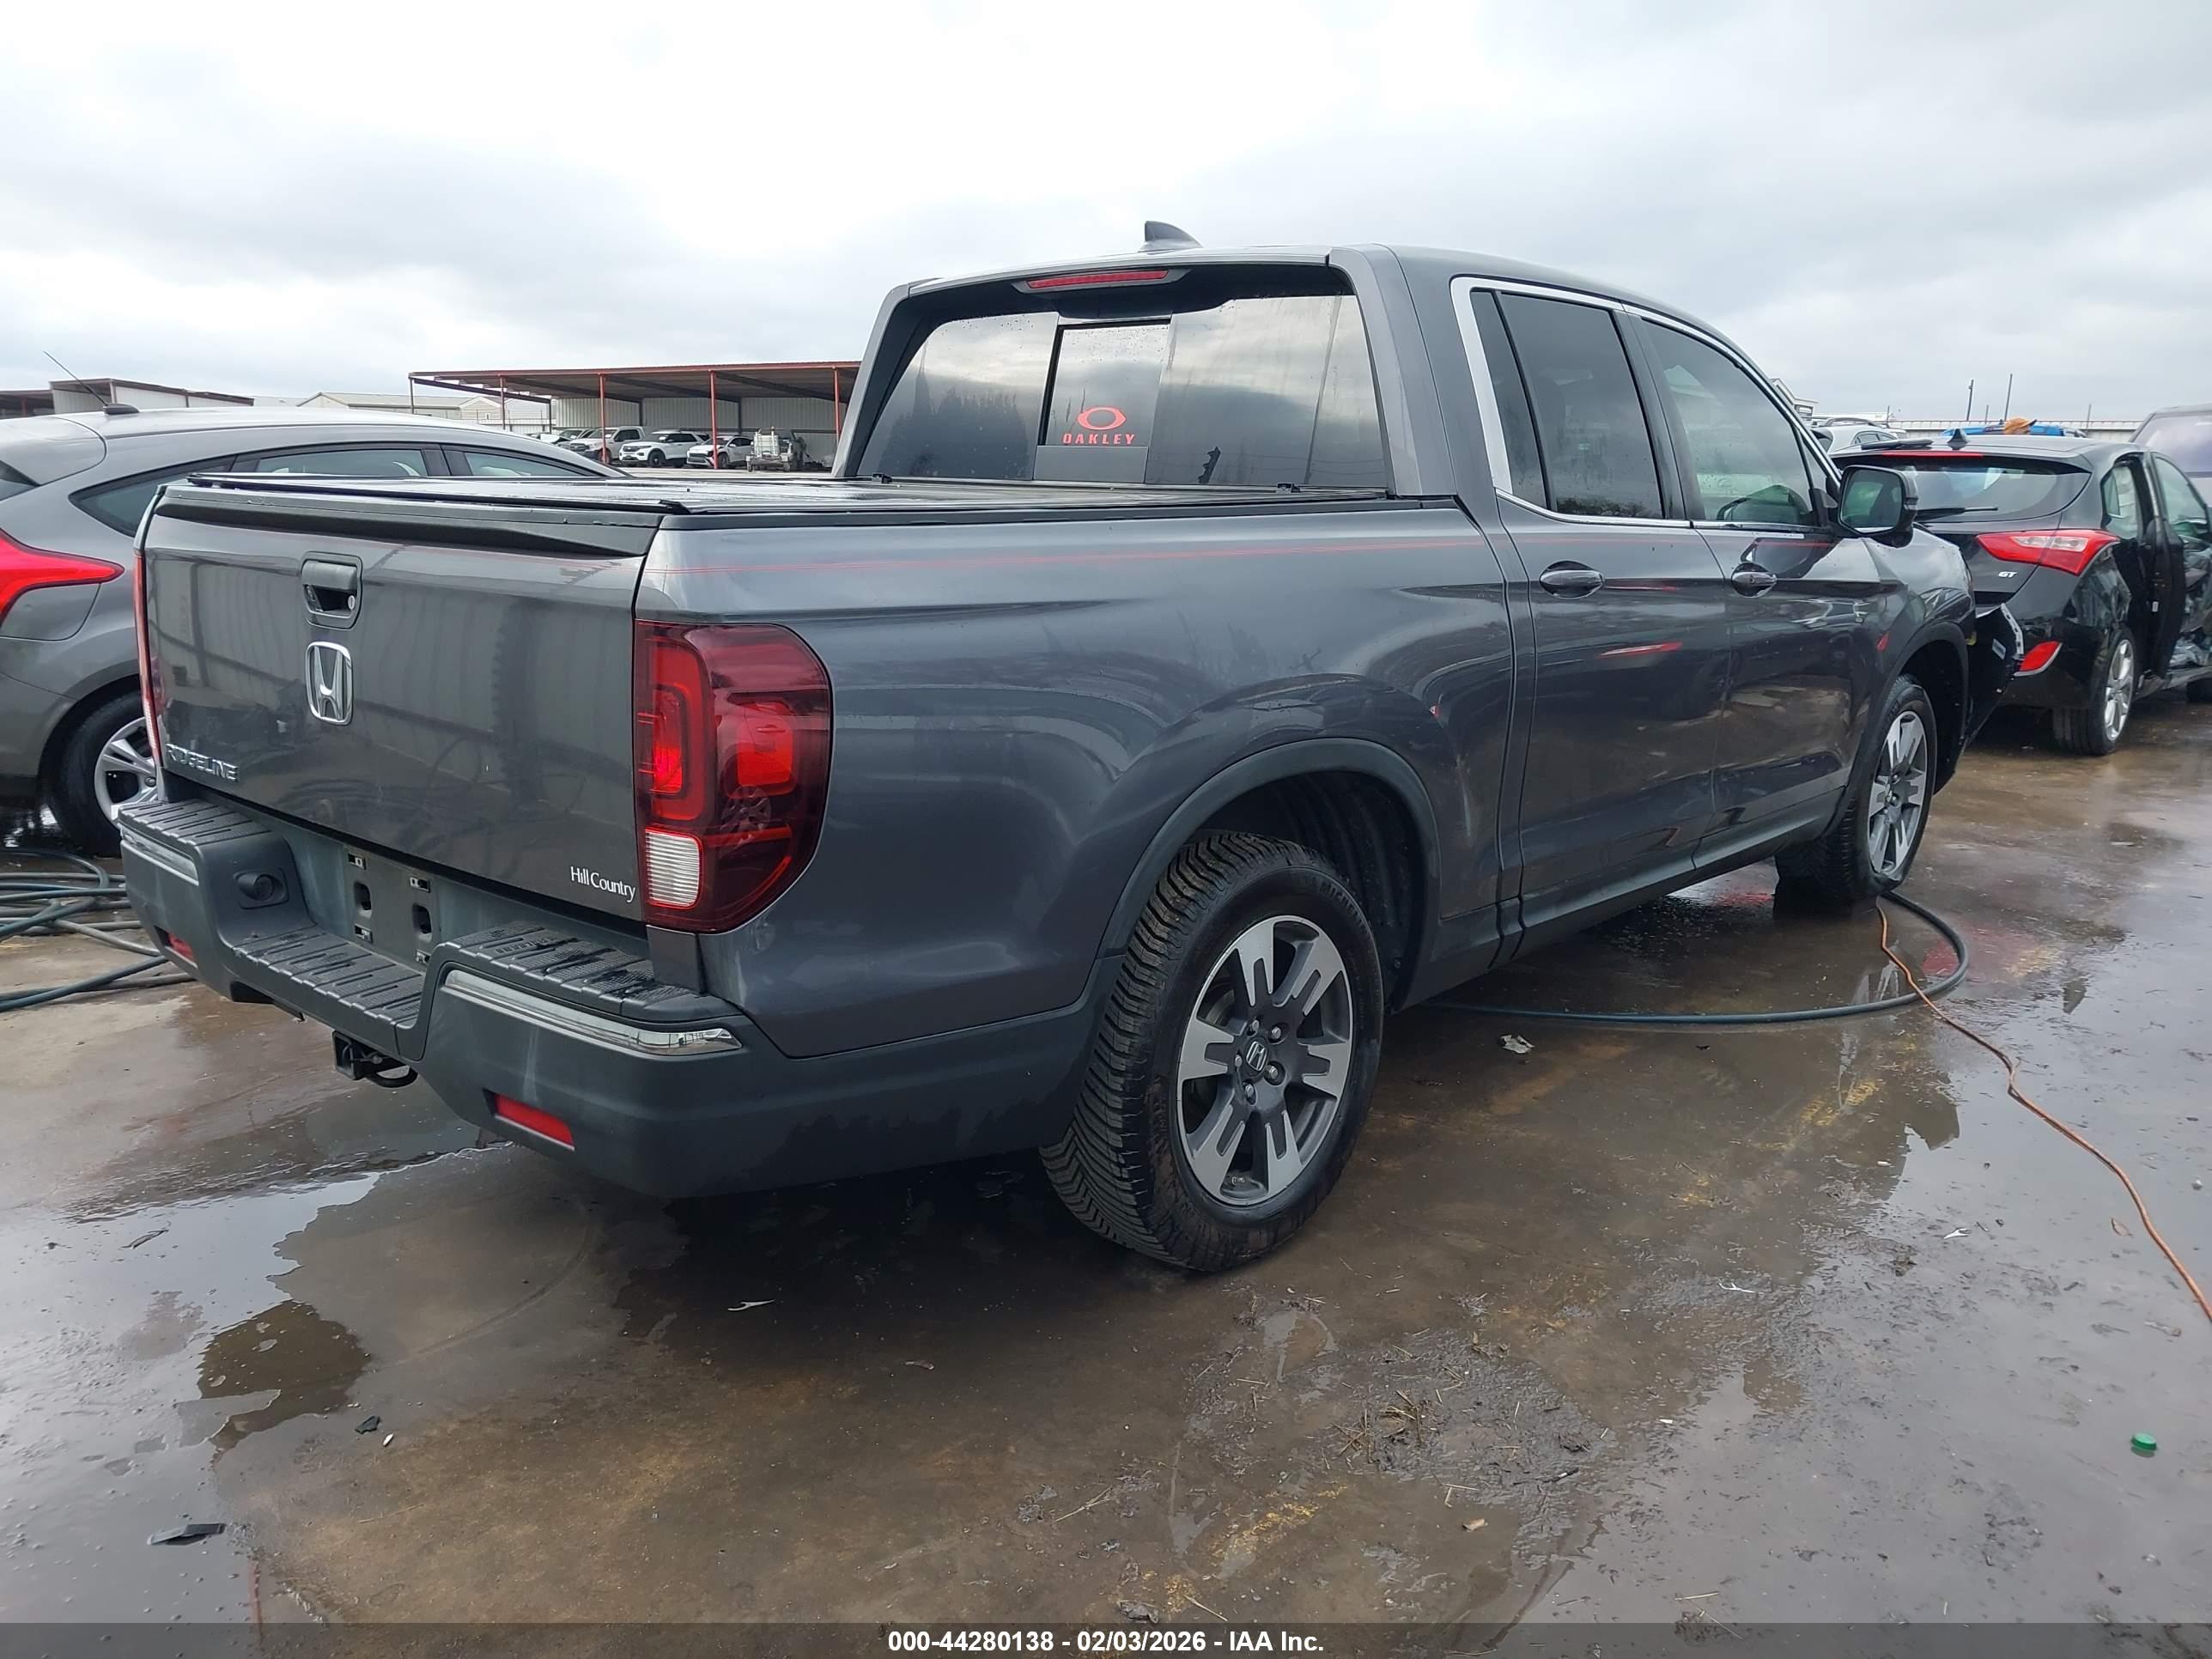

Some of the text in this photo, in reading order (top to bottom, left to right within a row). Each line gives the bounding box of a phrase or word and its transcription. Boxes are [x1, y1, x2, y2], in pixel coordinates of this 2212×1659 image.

[1063, 433, 1134, 445] OAKLEY
[570, 866, 636, 902] Hill Country
